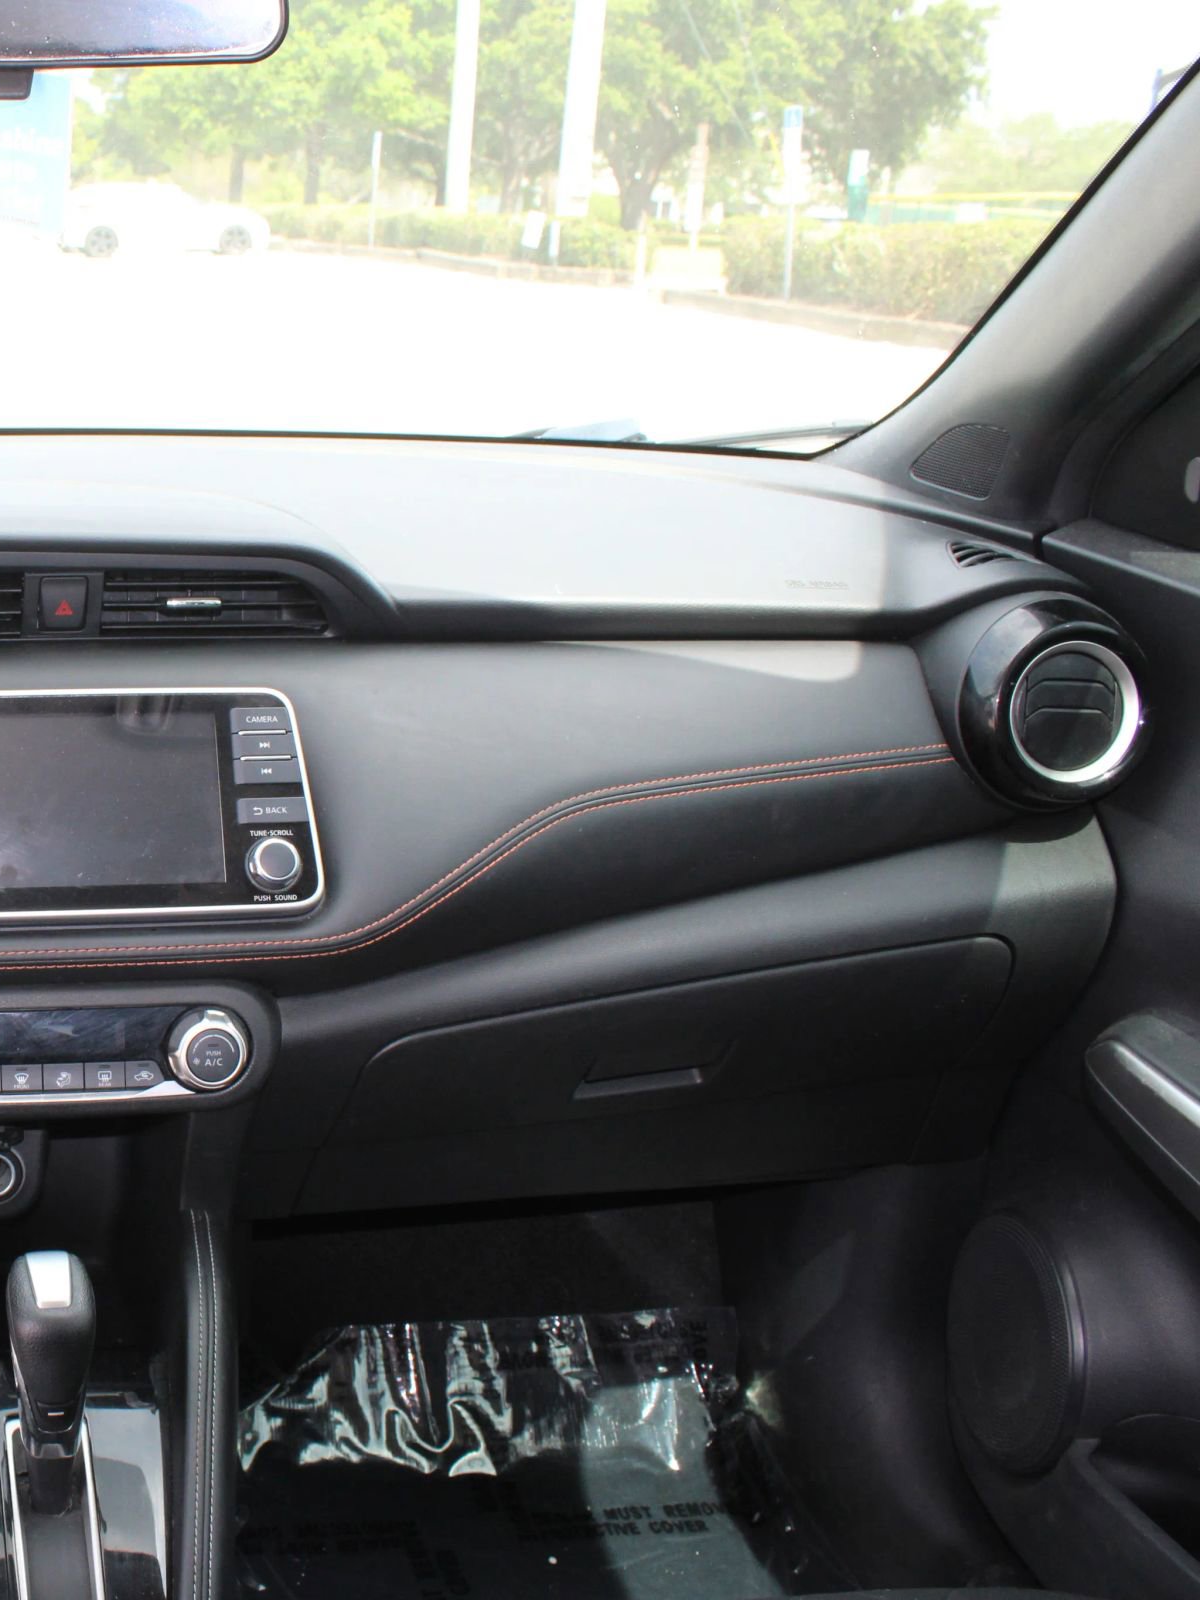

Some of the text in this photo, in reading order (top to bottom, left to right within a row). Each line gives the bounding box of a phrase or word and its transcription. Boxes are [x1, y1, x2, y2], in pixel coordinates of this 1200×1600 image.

[246, 715, 278, 723] CAMERA
[265, 806, 288, 814] BACK
[204, 1059, 223, 1067] A/C
[603, 1505, 652, 1520] MUST
[663, 1502, 730, 1518] REMOV
[648, 1520, 709, 1535] COVER
